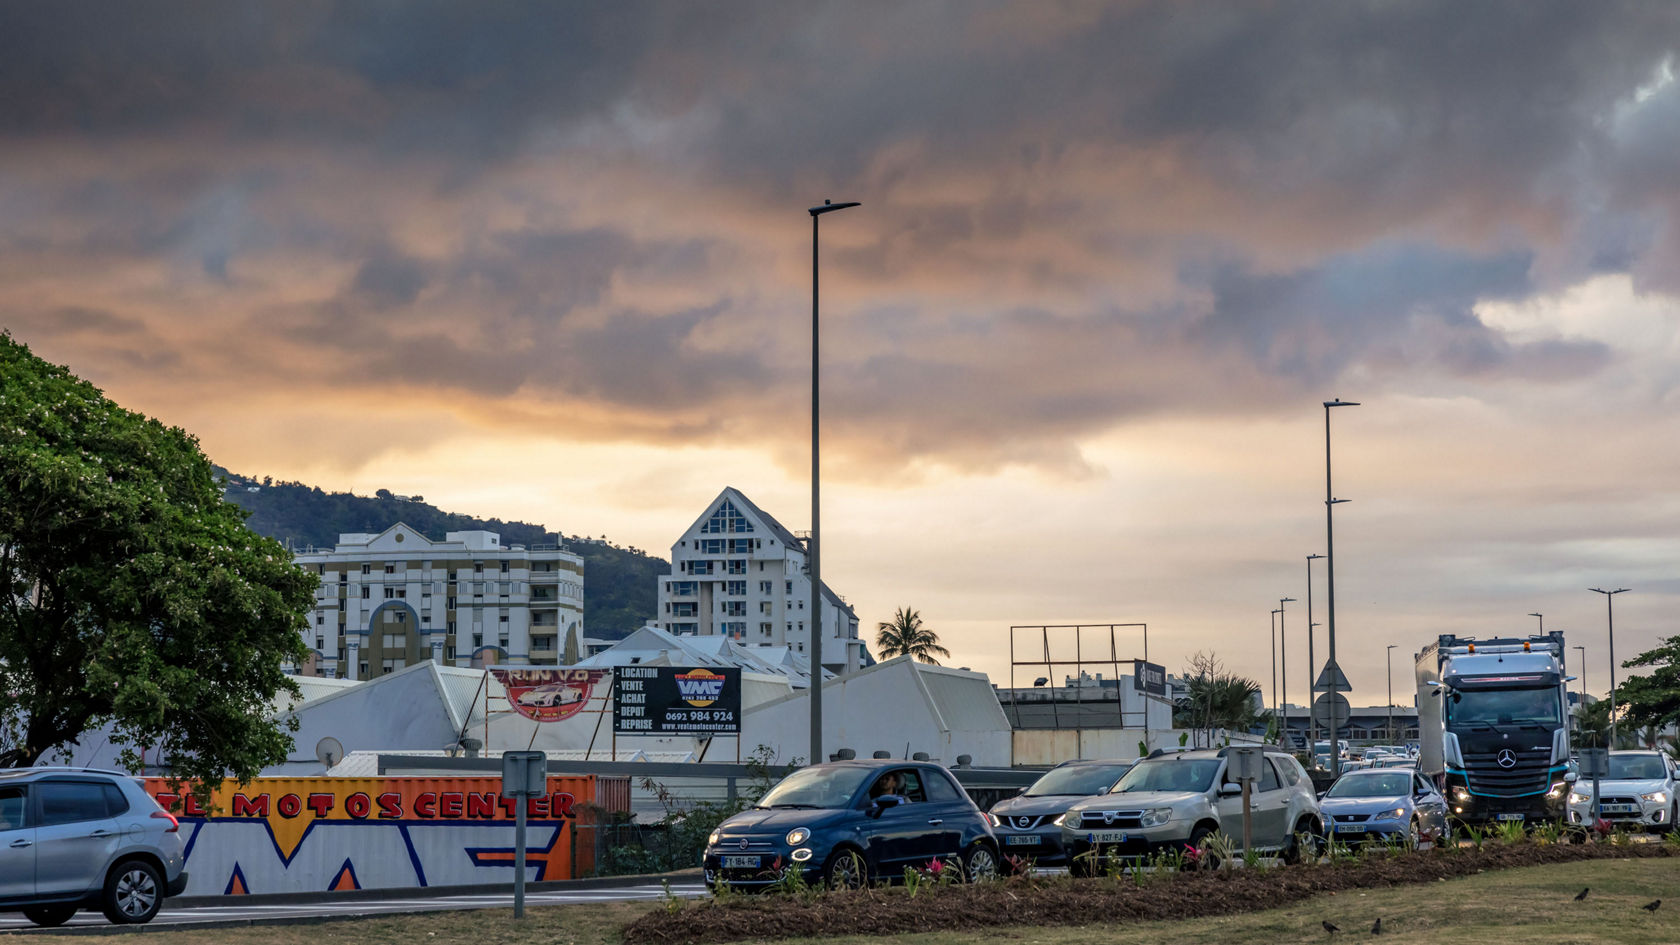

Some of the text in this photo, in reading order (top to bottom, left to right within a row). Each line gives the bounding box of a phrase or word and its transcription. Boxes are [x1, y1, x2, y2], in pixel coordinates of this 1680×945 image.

[621, 668, 658, 678] LOCATION
[621, 680, 644, 691] VENTE
[678, 680, 722, 695] VMC
[621, 693, 646, 704] ACHAT
[621, 706, 645, 717] DEPOT
[665, 711, 734, 721] 0692 984 924
[621, 719, 653, 730] REPRISE
[232, 792, 404, 818] MOTOS
[413, 792, 576, 818] CENTER
